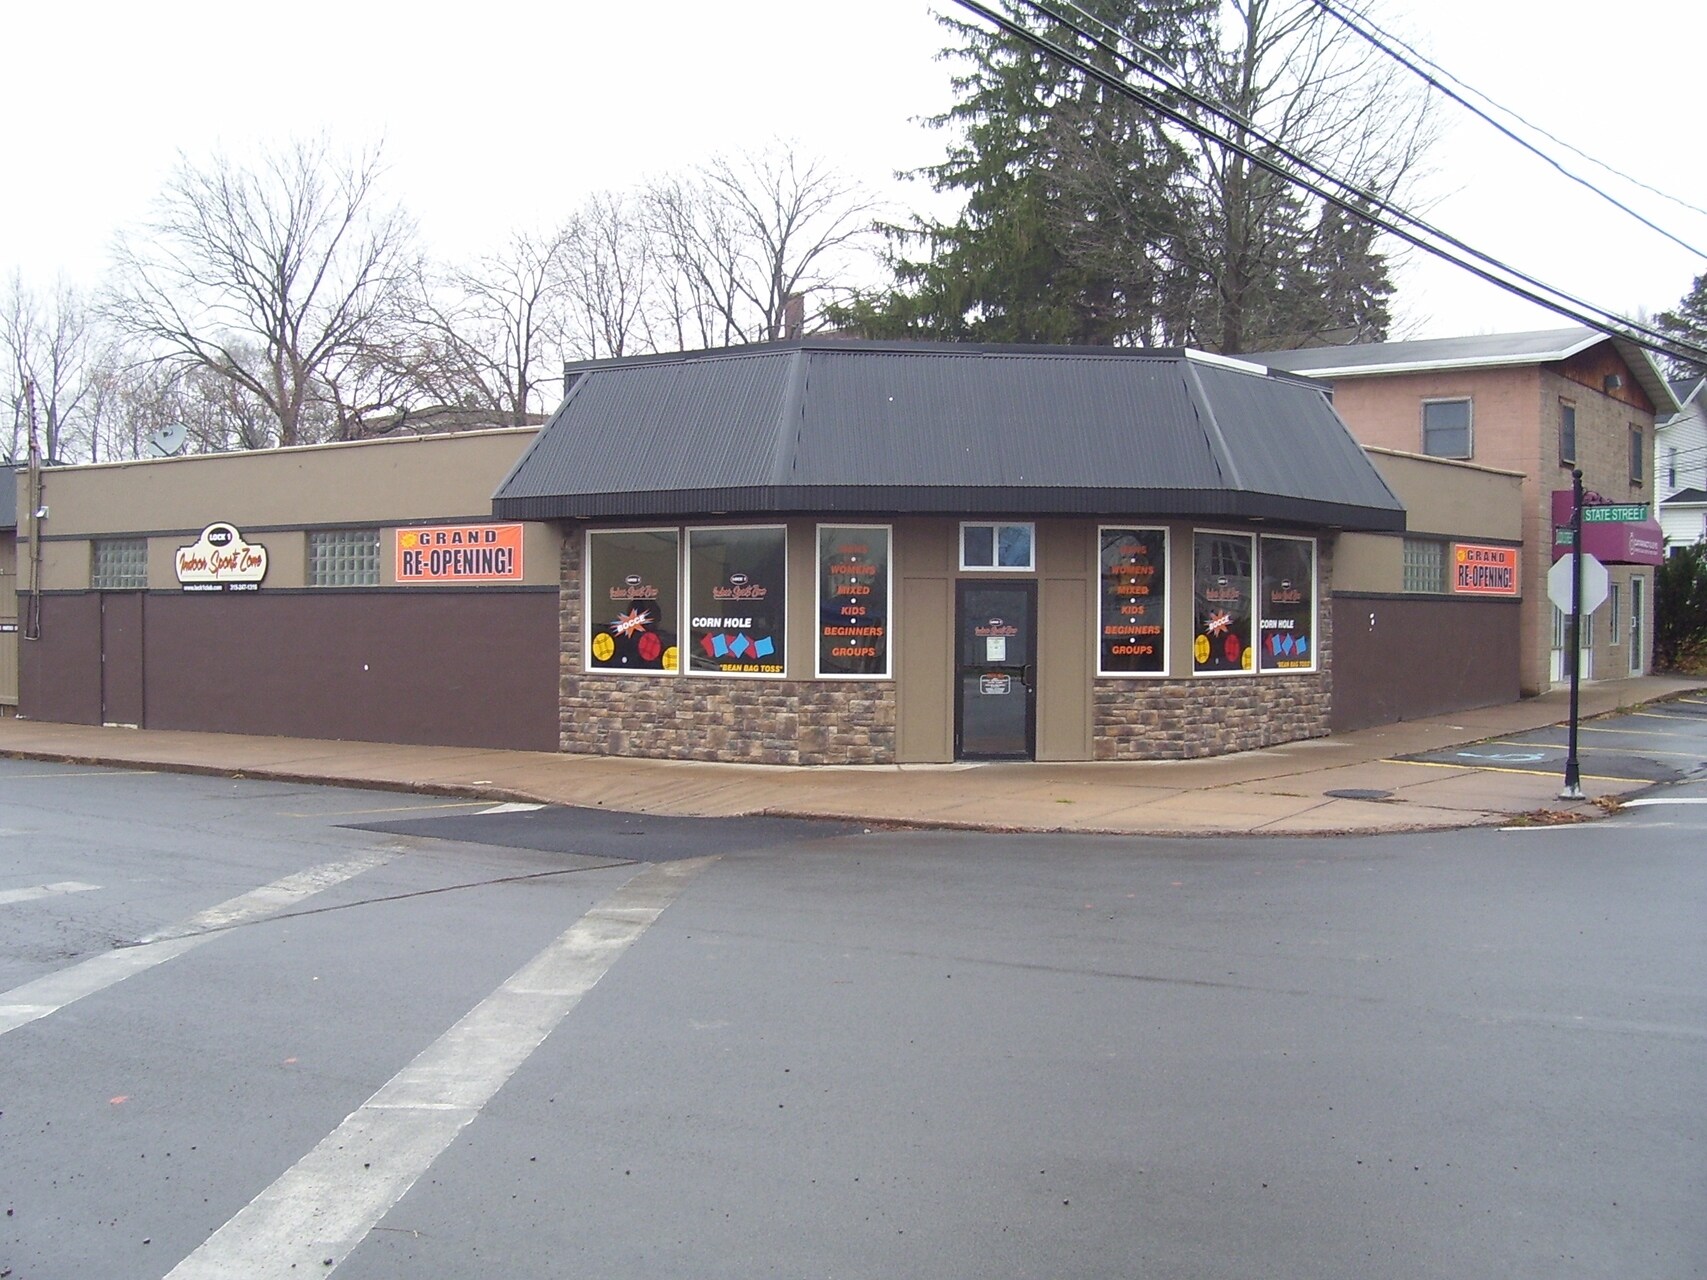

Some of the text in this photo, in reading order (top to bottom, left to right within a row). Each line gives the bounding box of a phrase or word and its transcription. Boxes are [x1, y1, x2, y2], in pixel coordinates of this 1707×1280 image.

[1585, 508, 1644, 521] STATE STREET
[209, 533, 231, 541] LOCK 1
[420, 530, 496, 545] GRAND
[1467, 550, 1505, 562] GRAND
[403, 548, 513, 575] RE-OPENING!
[831, 565, 876, 574] WOMENS
[1111, 566, 1155, 574] WOMENS
[1458, 565, 1512, 588] RE-OPENING!
[837, 586, 870, 595] MIXED
[1117, 586, 1149, 595] MIXED
[841, 606, 866, 615] KIDS
[1121, 606, 1145, 614] KIDS
[616, 614, 646, 632] BOCCE
[692, 617, 752, 628] CORN HOLE
[1209, 615, 1230, 630] BOCCE
[1260, 619, 1294, 629] CORN HOLE
[824, 627, 884, 636] BEGINNERS
[1104, 626, 1160, 634] BEGINNERS
[832, 647, 875, 656] GROUPS
[1112, 646, 1153, 654] GROUPS
[743, 664, 759, 672] BAG
[760, 664, 783, 672] TOSS"
